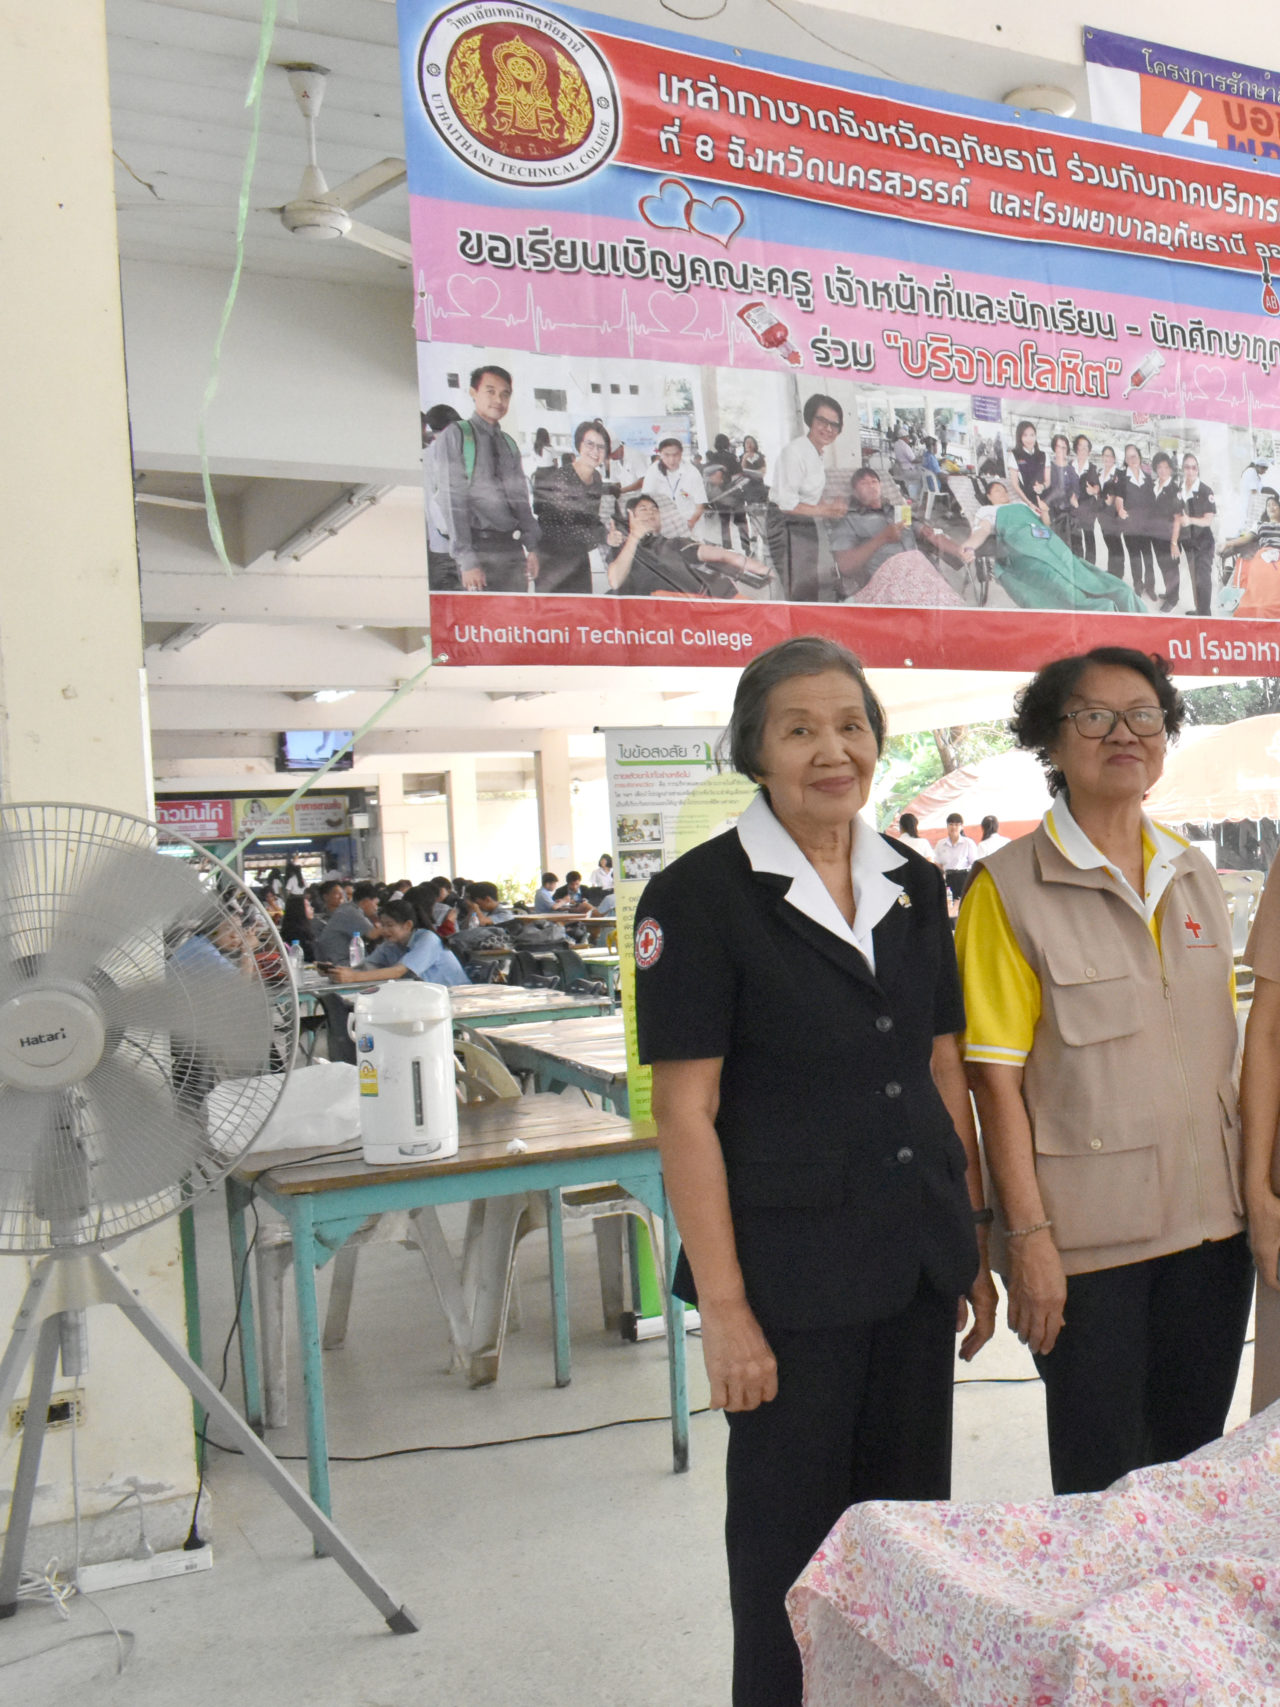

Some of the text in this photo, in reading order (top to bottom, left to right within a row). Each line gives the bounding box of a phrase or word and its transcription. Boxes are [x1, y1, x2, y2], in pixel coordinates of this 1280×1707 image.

[431, 93, 610, 178] UTHAITHANI TECHNICAL COLLEGE
[658, 71, 1059, 178] เหล่ากาชาดจังหวัดอุทัยธานี
[658, 118, 682, 156] ที่
[695, 134, 714, 163] 8
[727, 136, 970, 209] จังหวัดนครสวรรค์
[988, 188, 1248, 256] และโรงพยาบาลอุทัยธานี
[457, 227, 815, 311] ขอเรียนเชิญคณะครู
[823, 264, 1118, 340] เจ้าหน้าที่และนักเรียน
[1126, 326, 1142, 336] -
[1265, 294, 1278, 310] AB
[810, 325, 876, 371] ร่วม
[453, 625, 753, 651] Uthaithani Technical College
[1168, 638, 1192, 660] ณ
[617, 743, 701, 759] ไขข้อสงสัย ?
[20, 1028, 67, 1048] Hatari
